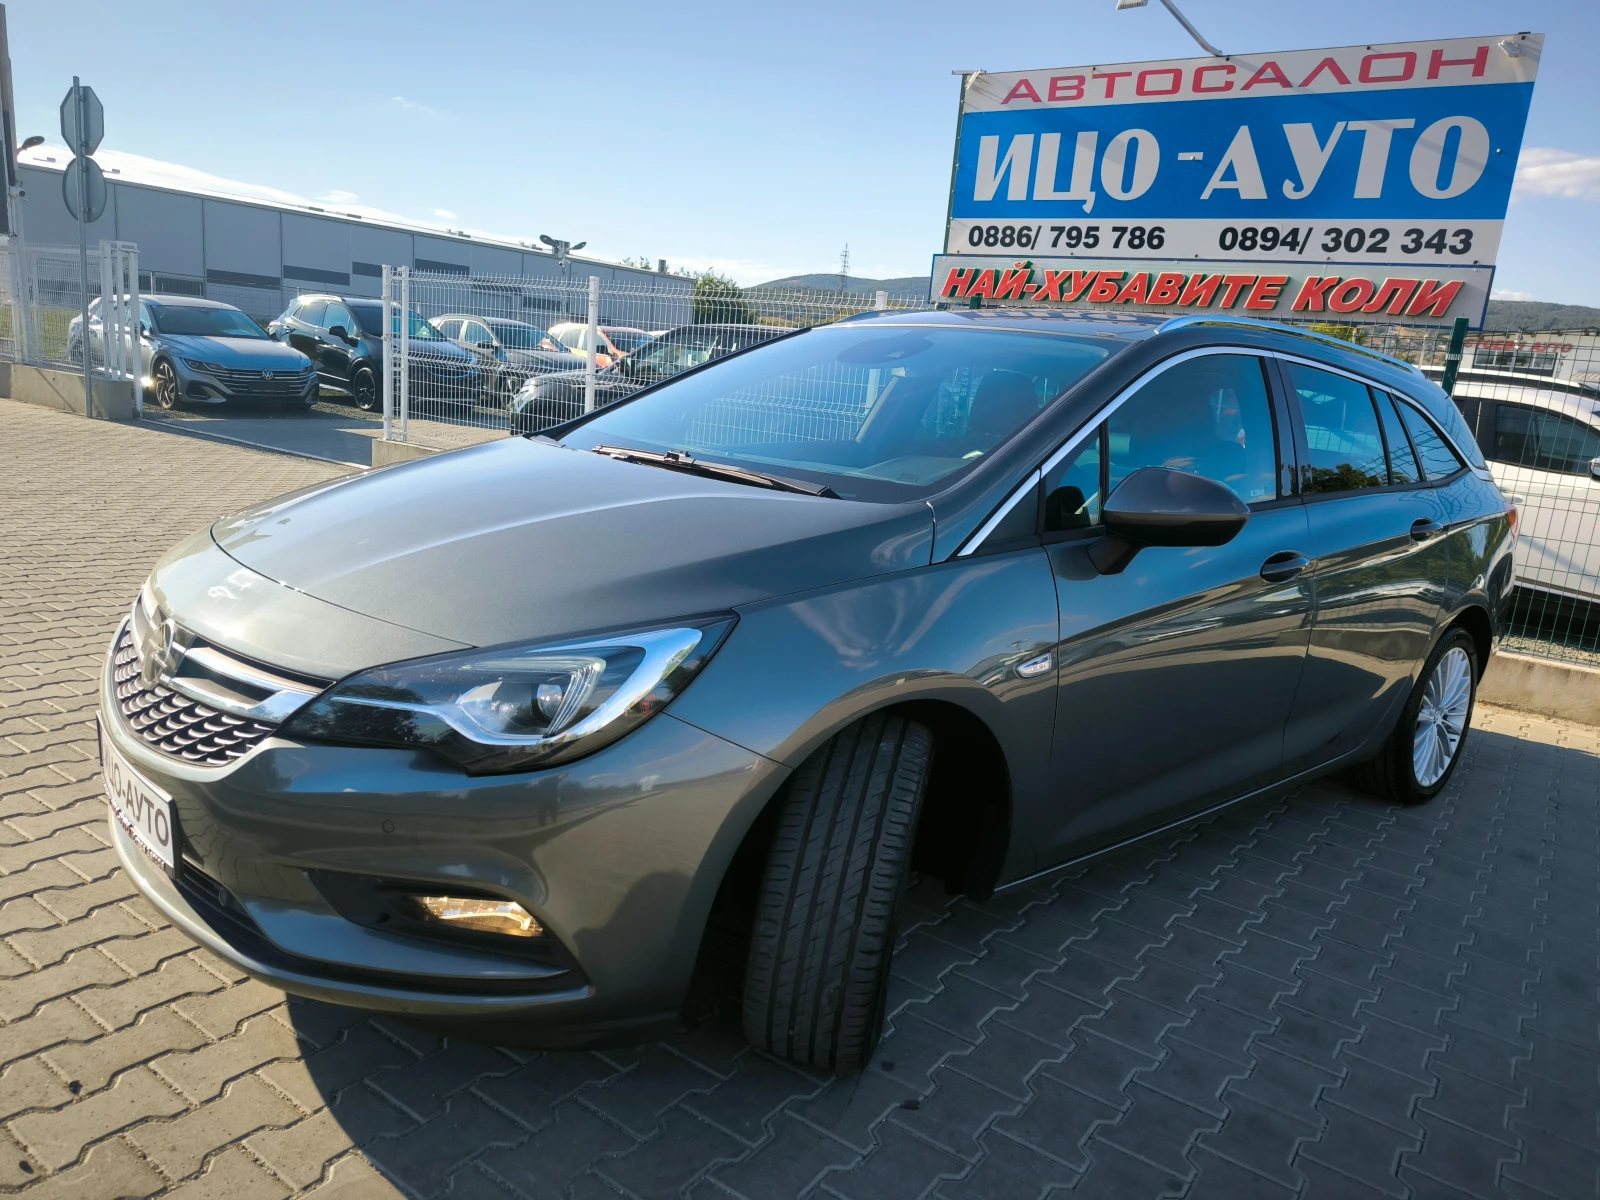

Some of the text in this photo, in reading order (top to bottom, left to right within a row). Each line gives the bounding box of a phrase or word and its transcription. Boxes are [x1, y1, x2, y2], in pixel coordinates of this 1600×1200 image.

[1001, 45, 1491, 105] АВТОСАЛОН
[968, 225, 1166, 250] 0886/ 795 786
[1218, 227, 1474, 255] 0894/ 302 343
[941, 261, 1465, 317] НАЙ-ХУБАВИТЕ КОЛИ
